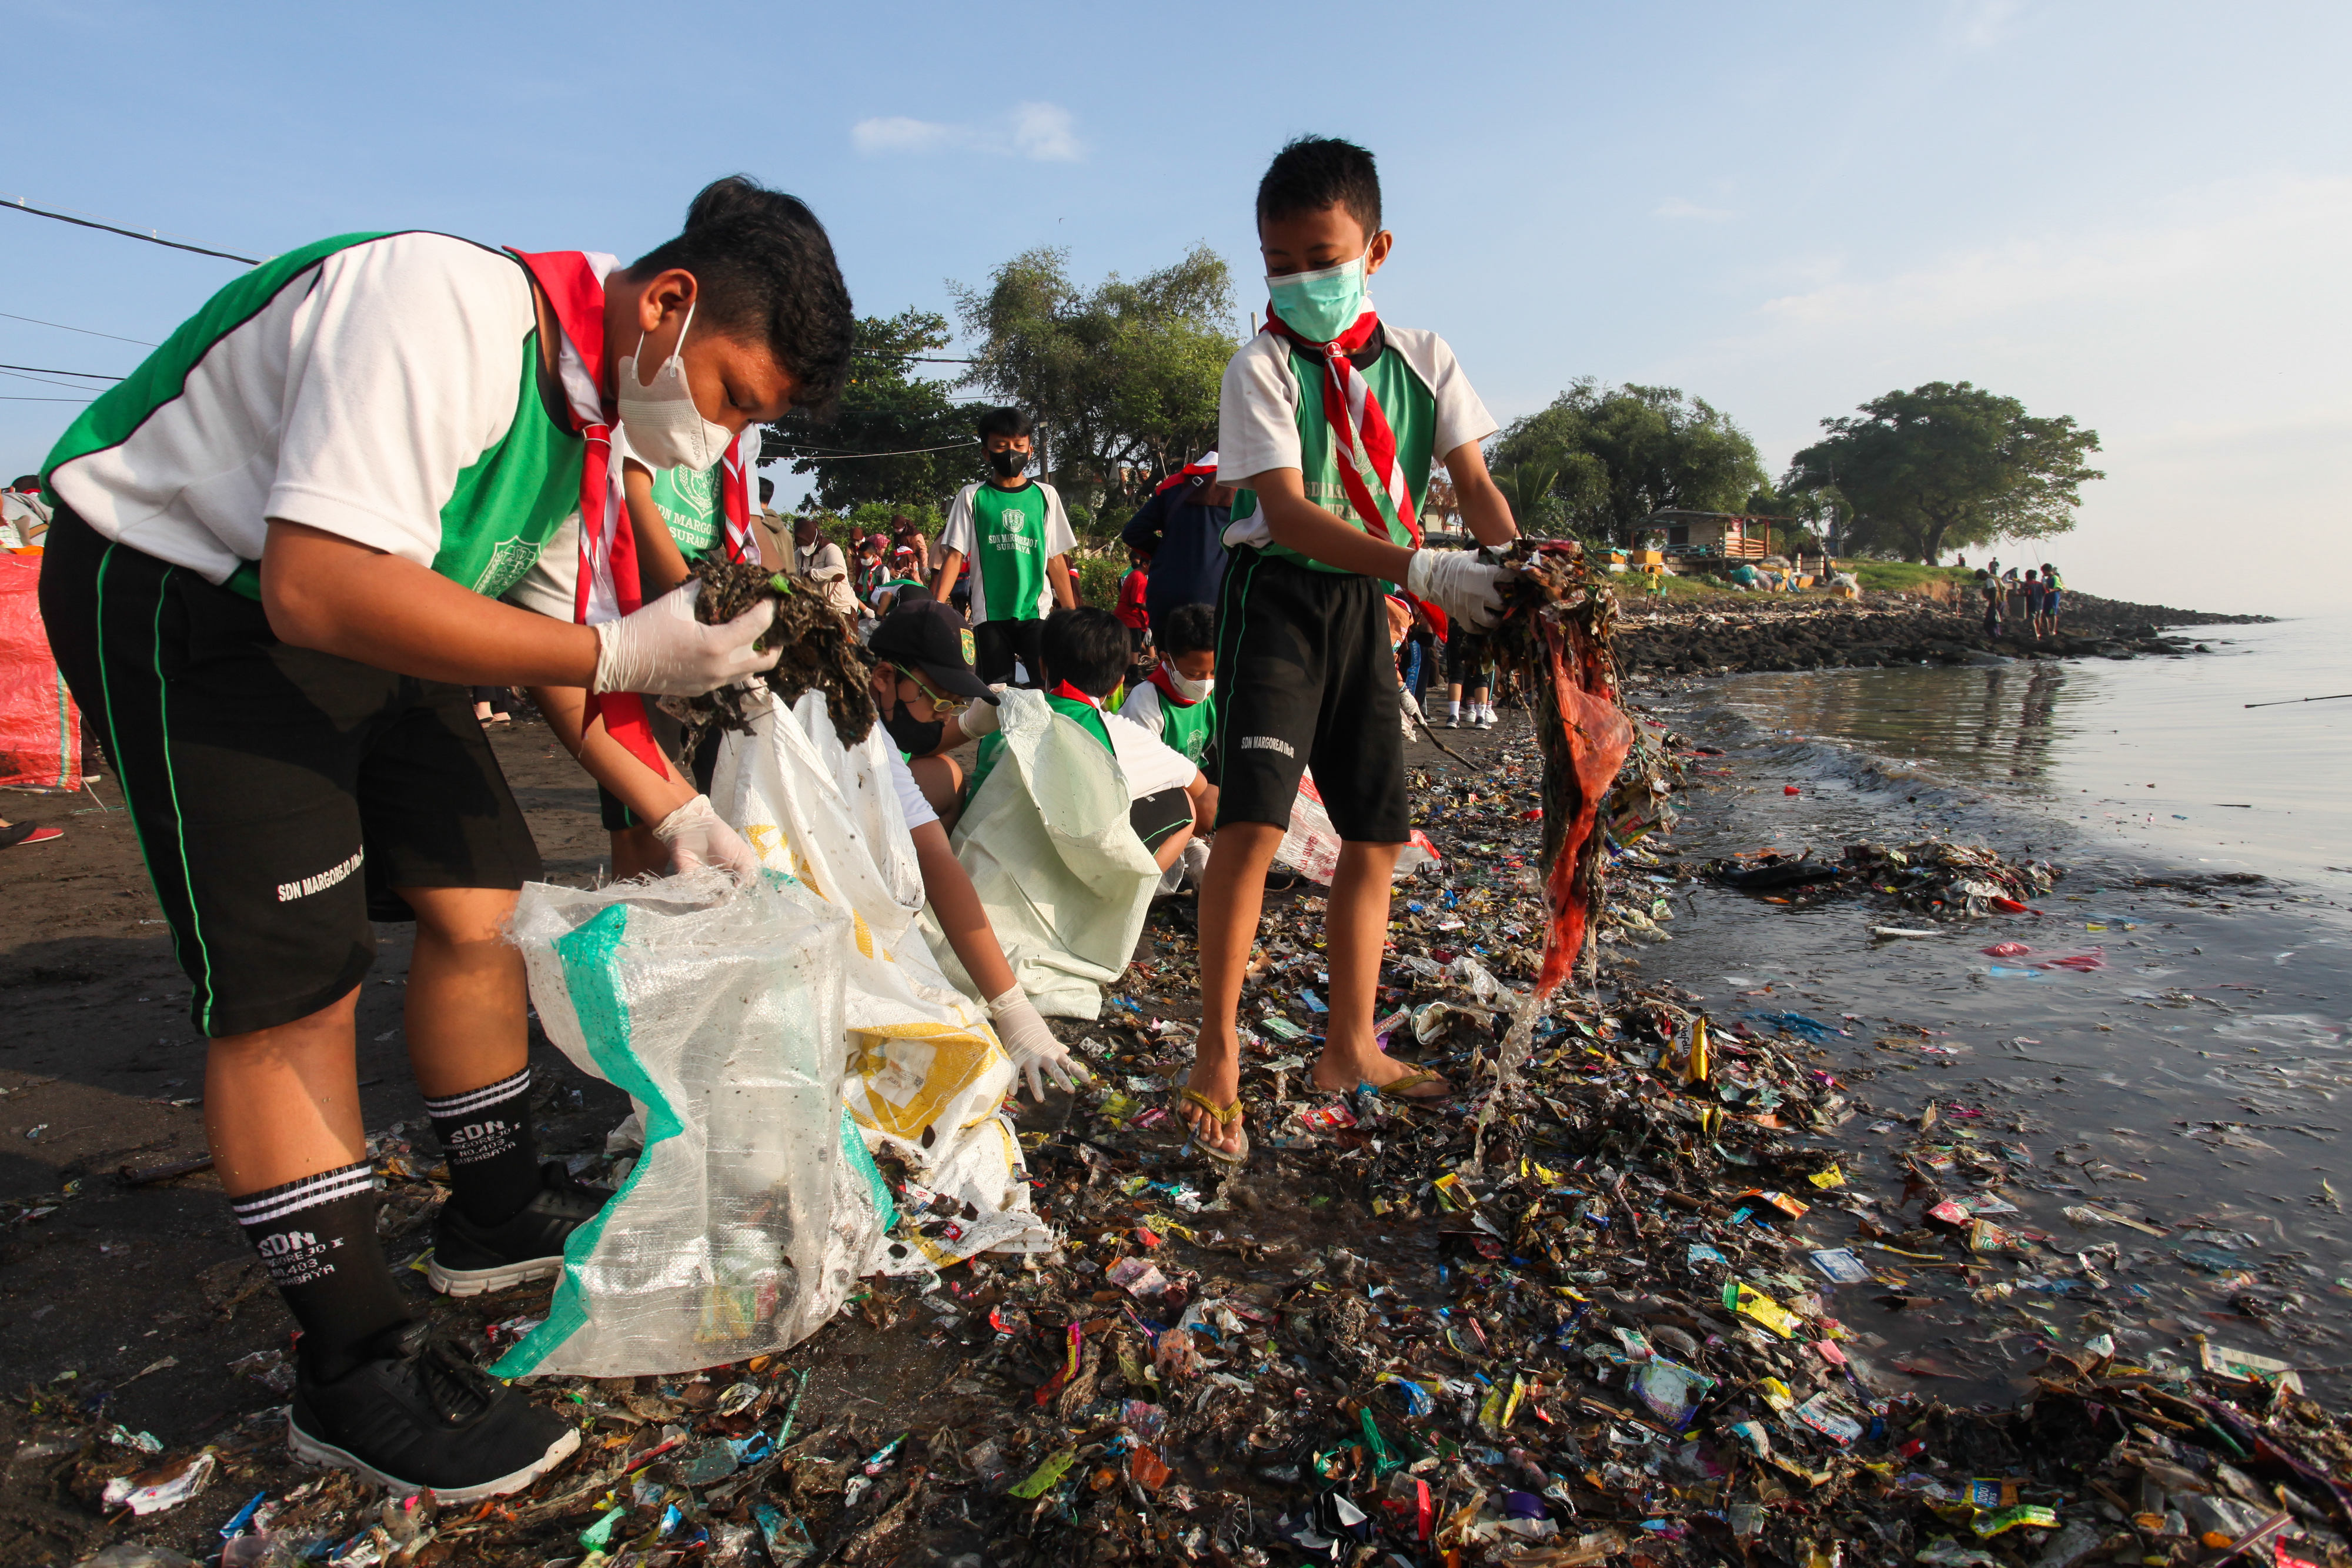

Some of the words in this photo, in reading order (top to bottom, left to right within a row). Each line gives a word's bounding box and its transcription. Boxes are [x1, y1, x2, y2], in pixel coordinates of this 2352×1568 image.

[654, 502, 672, 521] DN
[988, 534, 1000, 544] SDN
[1001, 534, 1034, 547] MARGOREJO
[1034, 540, 1038, 548] I
[997, 543, 1031, 555] SURABAYA
[1241, 737, 1252, 749] SDN
[1253, 736, 1284, 753] MARGOREJO
[278, 881, 302, 902] SDN
[302, 859, 350, 896] MARGOREJO
[442, 1128, 510, 1149] MARGOREJO
[450, 1121, 506, 1144] SDN
[453, 1142, 516, 1165] SURABAYA
[257, 1231, 317, 1258] SDN
[403, 1332, 417, 1341] PRO
